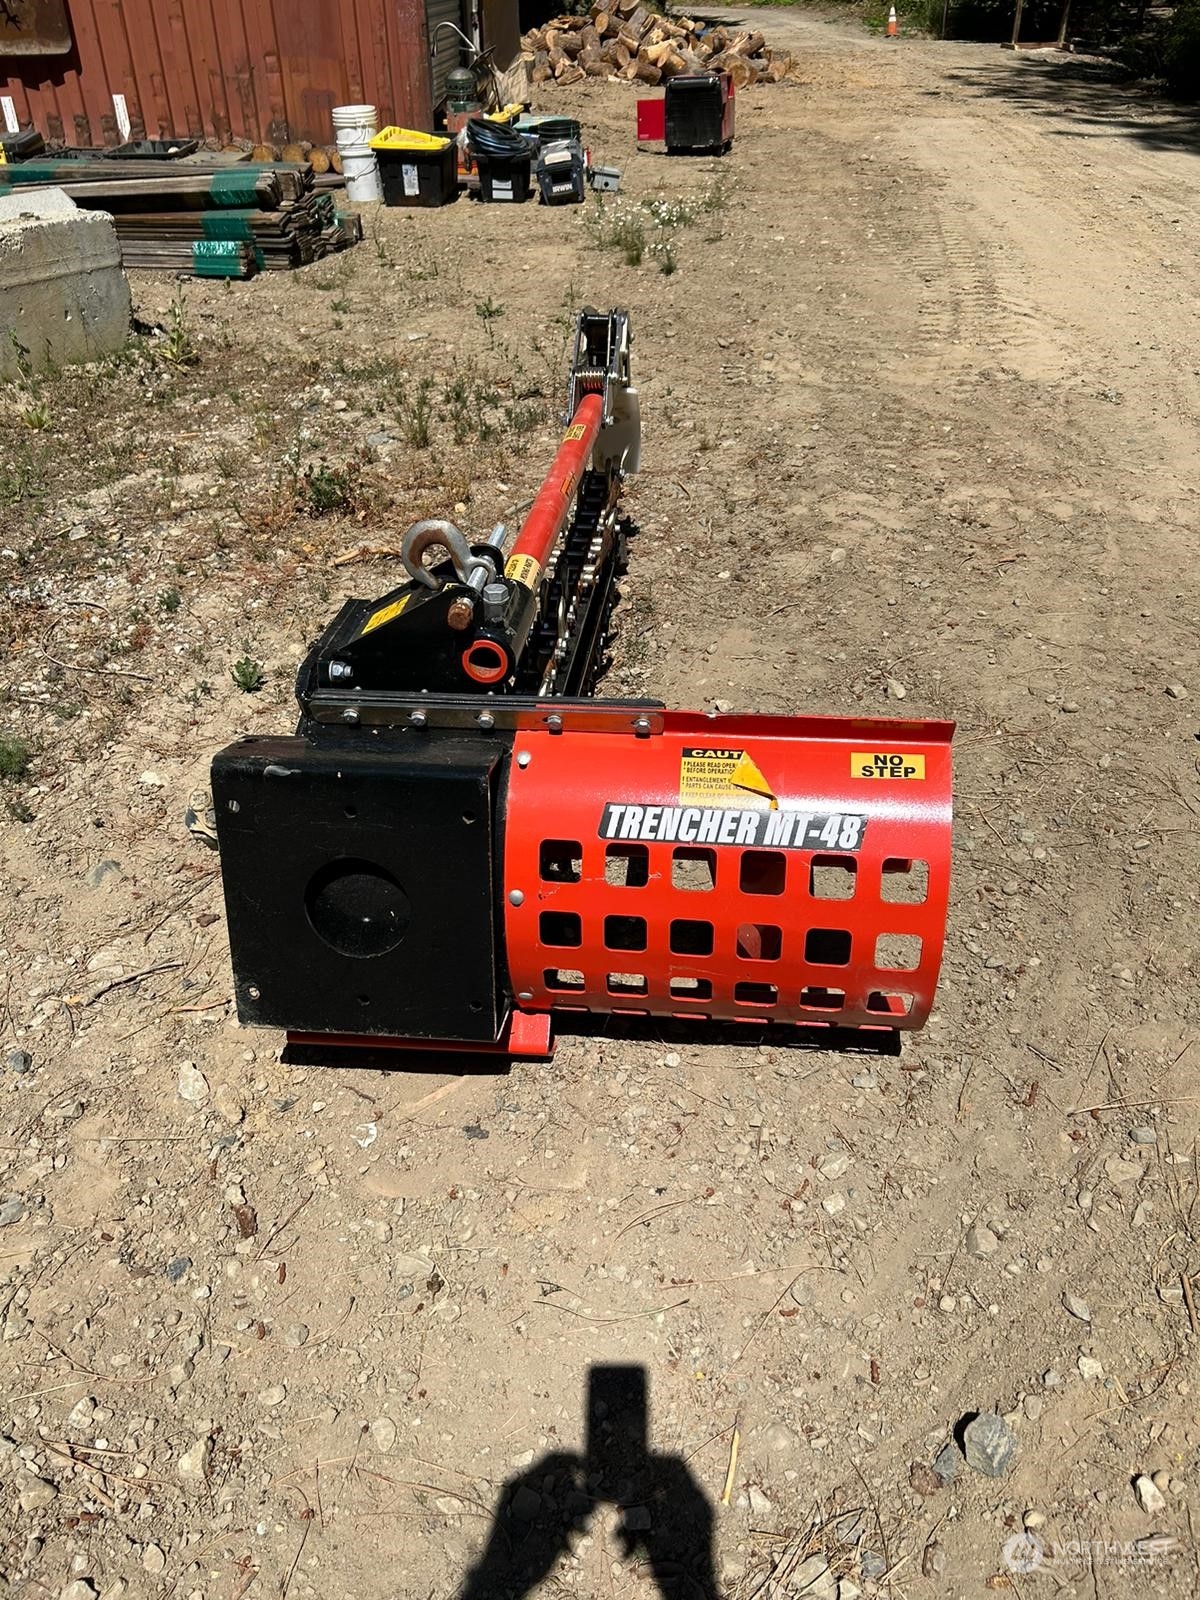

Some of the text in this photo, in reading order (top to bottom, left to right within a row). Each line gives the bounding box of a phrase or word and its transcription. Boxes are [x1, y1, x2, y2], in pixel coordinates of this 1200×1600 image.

[552, 183, 573, 193] IRWIN
[691, 750, 741, 758] CAUT
[874, 754, 904, 766] NO
[861, 765, 916, 778] STEP
[686, 776, 727, 784] ENTANGLEMENT
[606, 805, 862, 849] TRENCHER MT-48
